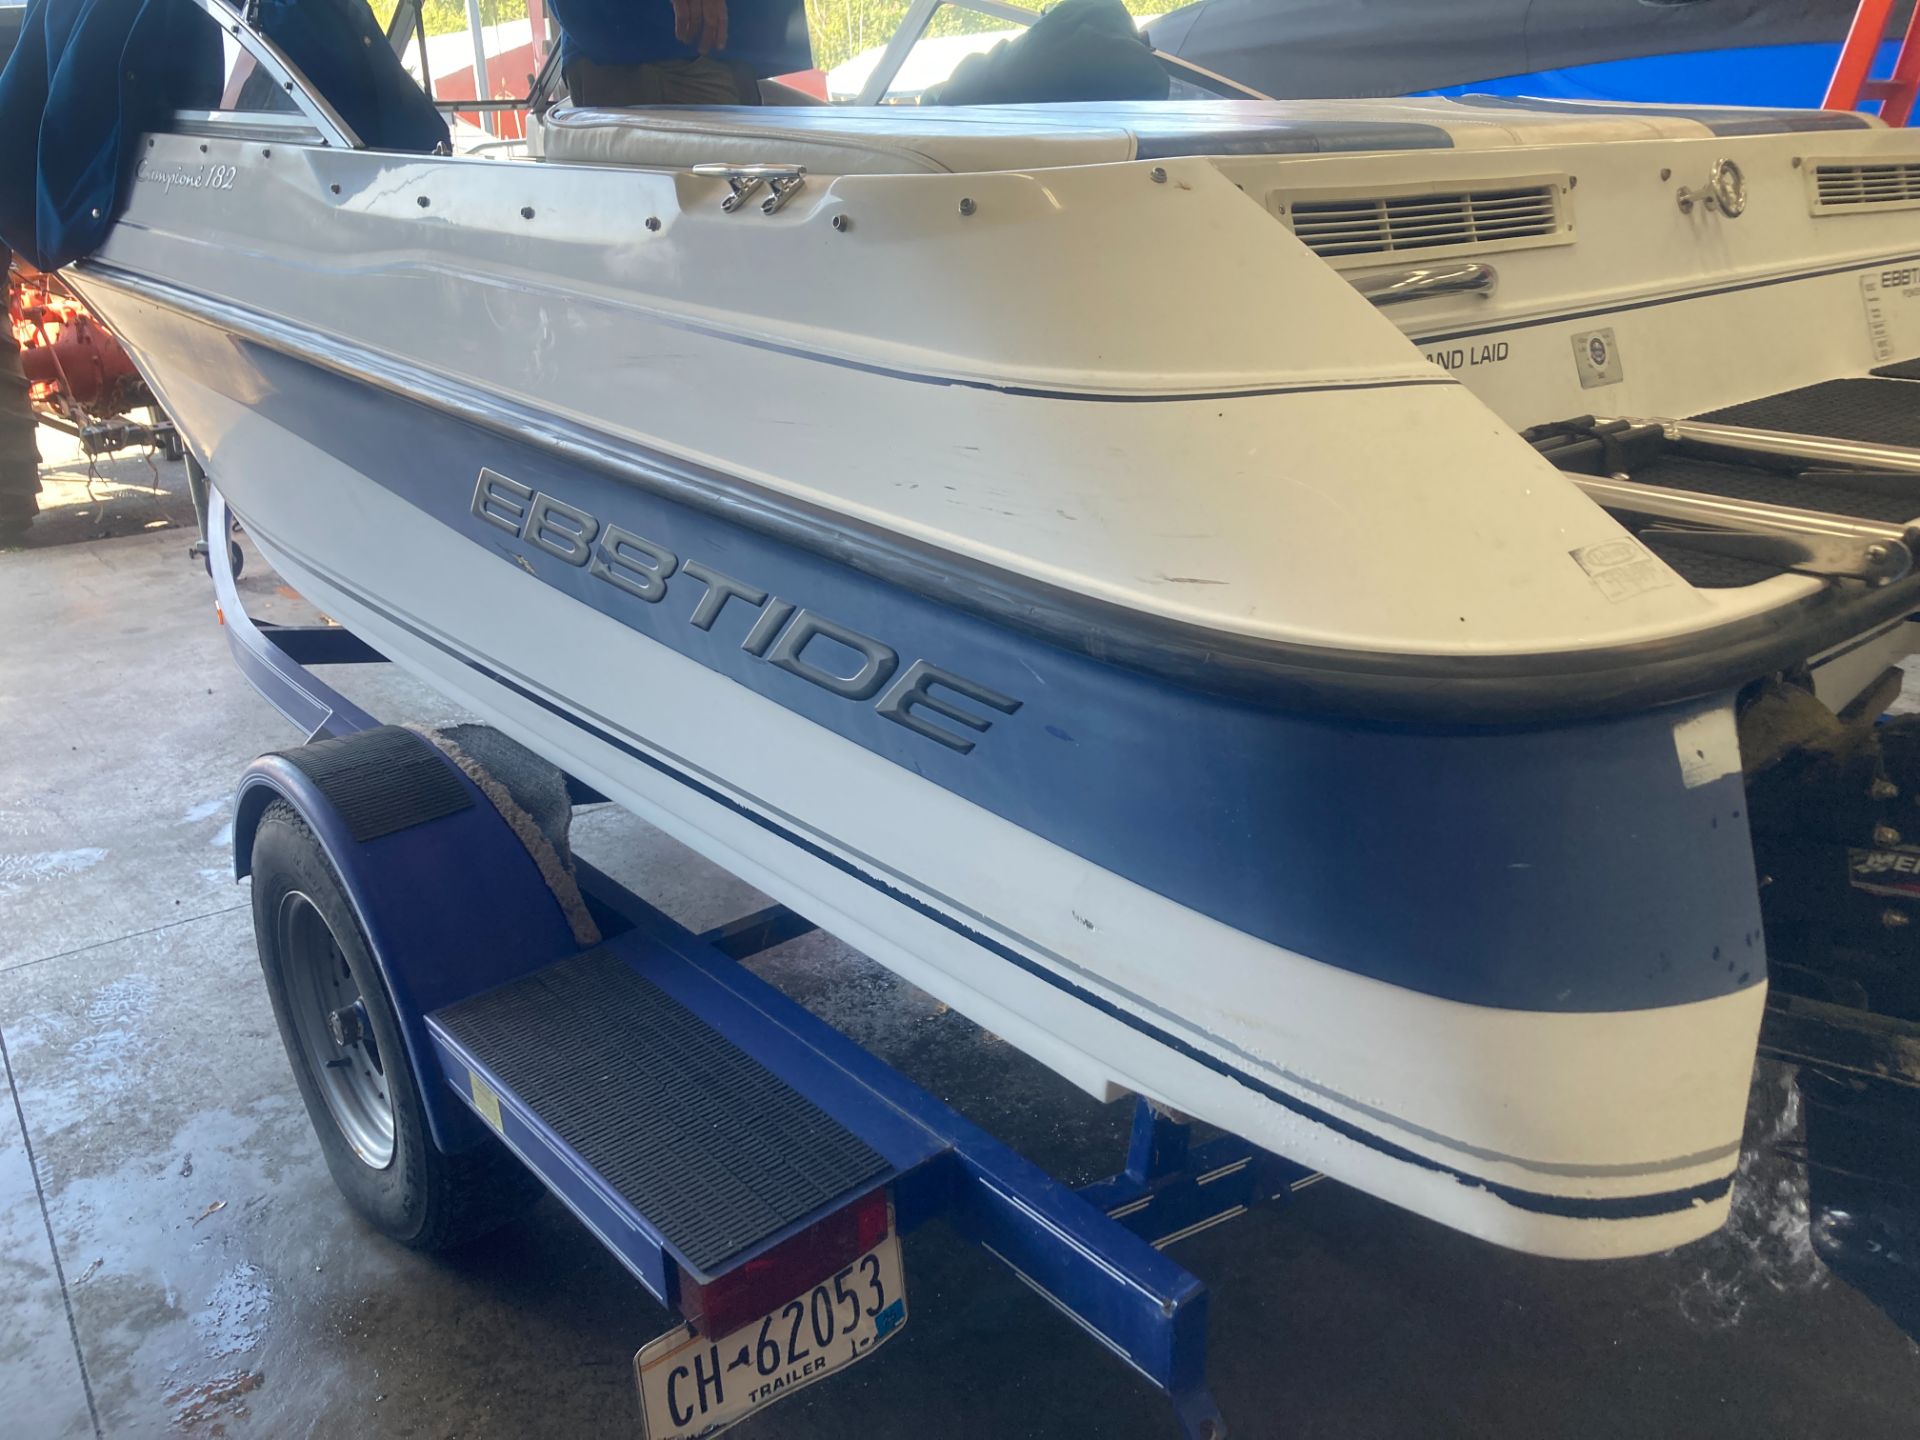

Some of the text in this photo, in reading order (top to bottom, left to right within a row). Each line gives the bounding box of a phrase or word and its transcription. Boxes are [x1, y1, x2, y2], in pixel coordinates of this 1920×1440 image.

[205, 164, 237, 190] 182
[1470, 342, 1509, 365] LAID
[470, 466, 1024, 756] EBBTIDE
[666, 1253, 885, 1428] CH 62053
[748, 1356, 827, 1403] TRAILER
